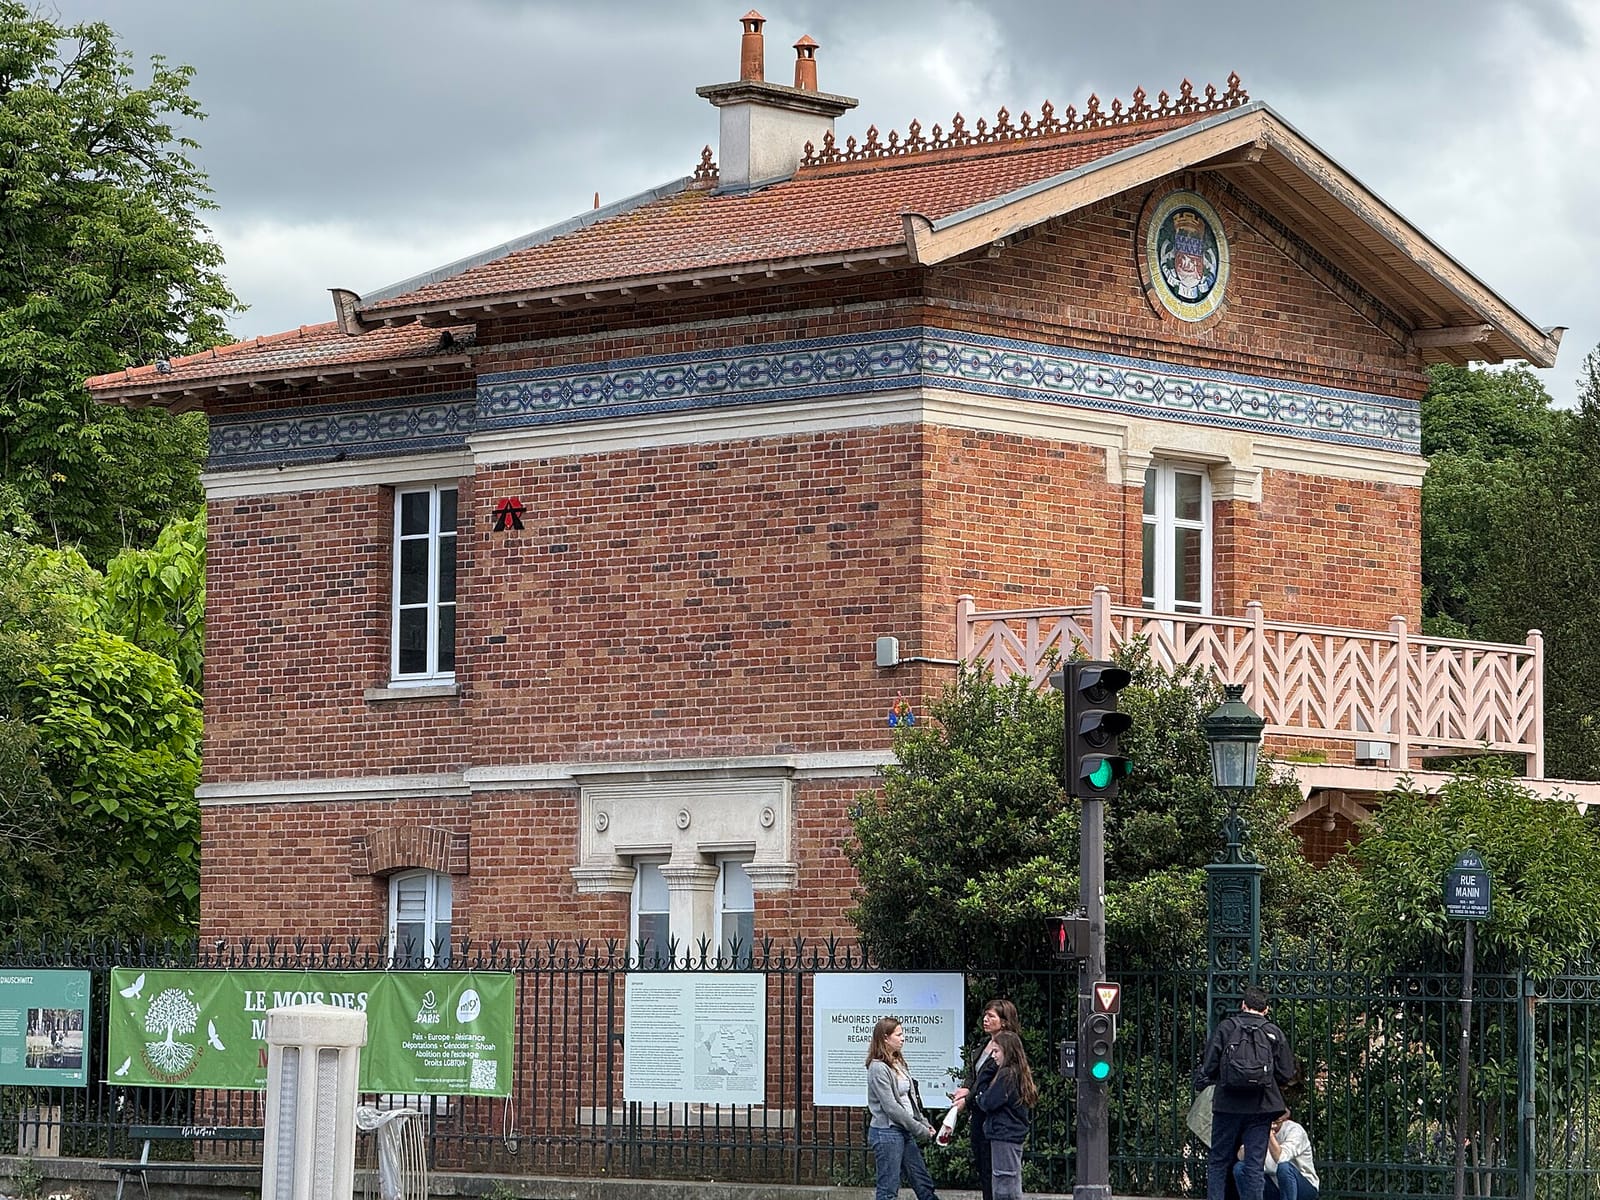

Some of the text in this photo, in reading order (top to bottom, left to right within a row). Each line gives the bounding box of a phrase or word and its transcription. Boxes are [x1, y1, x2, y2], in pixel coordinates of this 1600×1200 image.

[1460, 875, 1476, 885] RUE
[1455, 887, 1480, 898] MANIN
[244, 990, 368, 1012] LE MOIS DES
[416, 1014, 440, 1024] PARIS
[831, 1013, 870, 1023] MÉMOIRES
[412, 1033, 423, 1041] Paix
[428, 1033, 450, 1042] Europe
[402, 1042, 438, 1050] Déportations
[475, 1043, 496, 1051] Shoah
